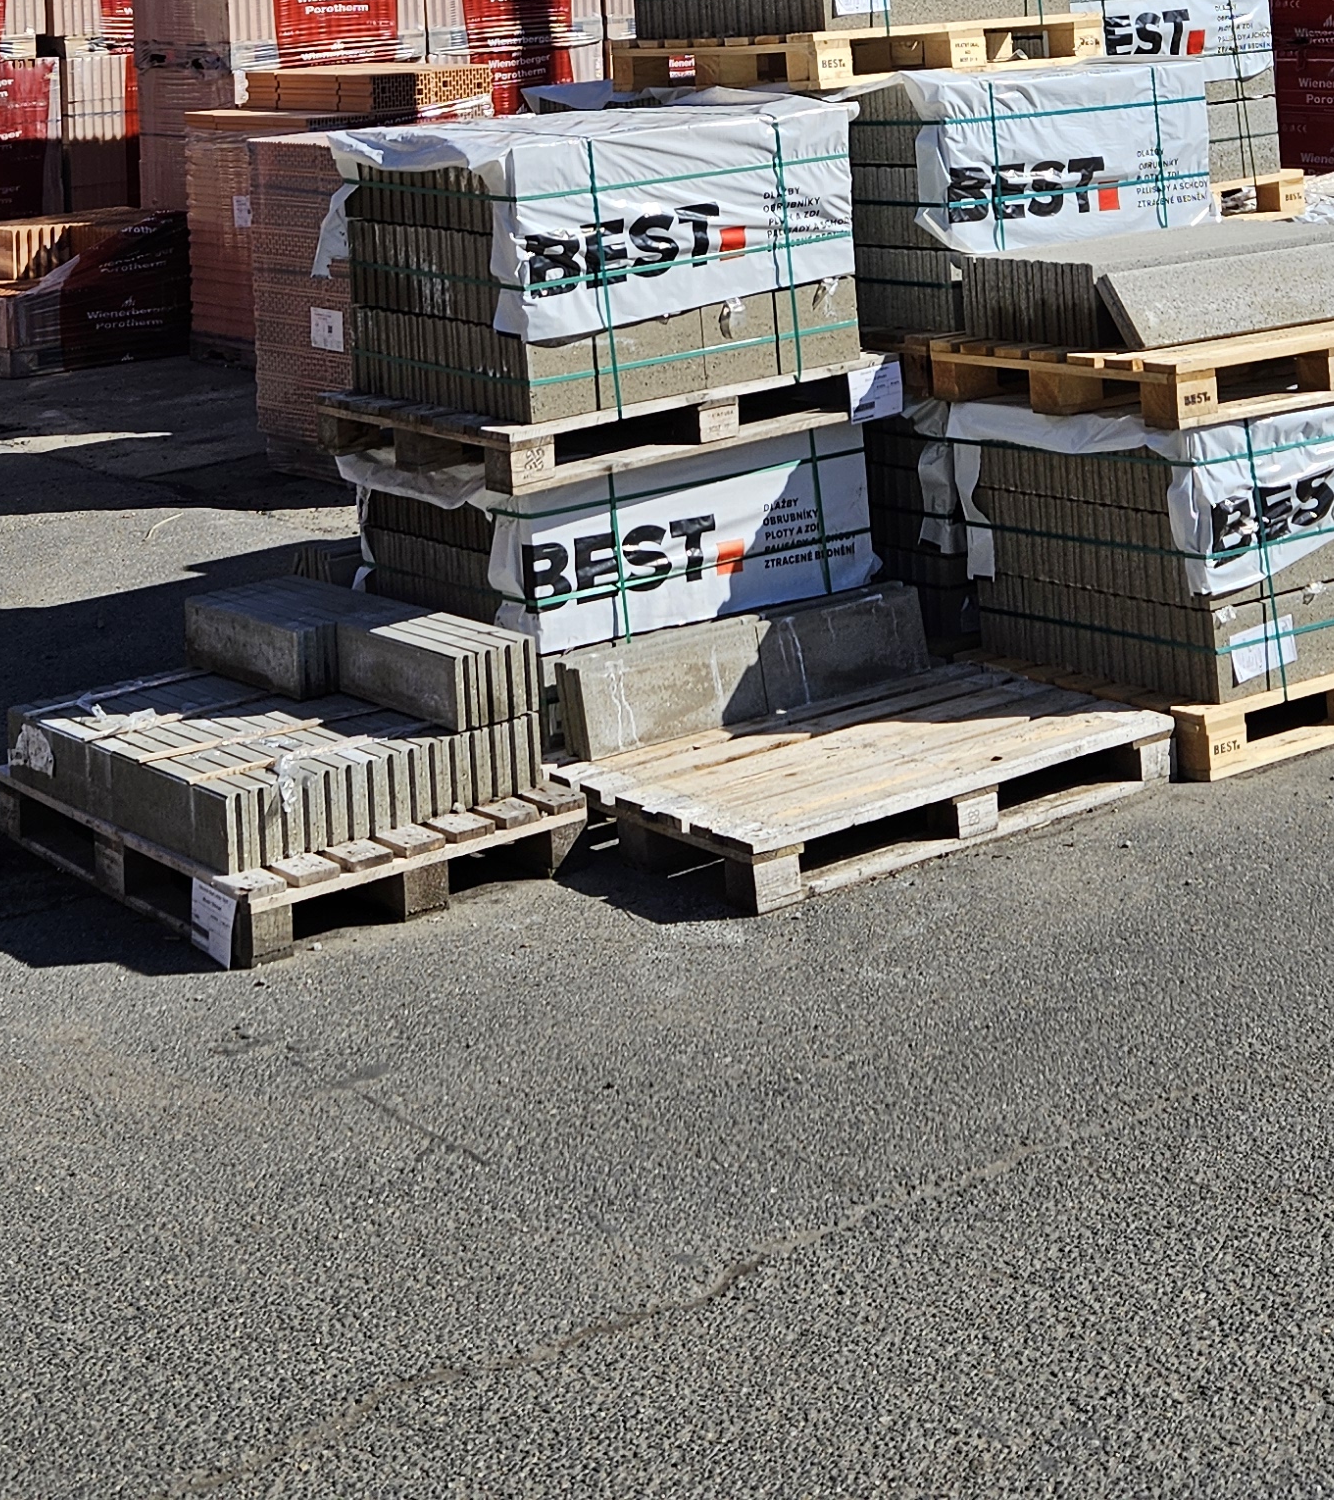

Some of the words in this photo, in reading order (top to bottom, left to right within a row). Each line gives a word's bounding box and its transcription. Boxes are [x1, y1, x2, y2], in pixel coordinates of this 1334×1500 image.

[305, 4, 368, 14] Porotherm
[488, 54, 551, 68] Wienerberger
[495, 67, 546, 81] Porotherm
[948, 156, 1104, 223] BEST
[525, 202, 719, 299] BEST
[1184, 392, 1208, 406] BEST
[764, 498, 798, 512] DLAŽBY
[763, 508, 818, 526] OBRUBNÍKY
[765, 526, 794, 541] PLOTY
[797, 526, 802, 534] A
[805, 523, 819, 533] ZDI
[522, 513, 715, 613] BEST
[764, 551, 812, 568] ZTRACENÉ
[1214, 742, 1236, 755] BEST
